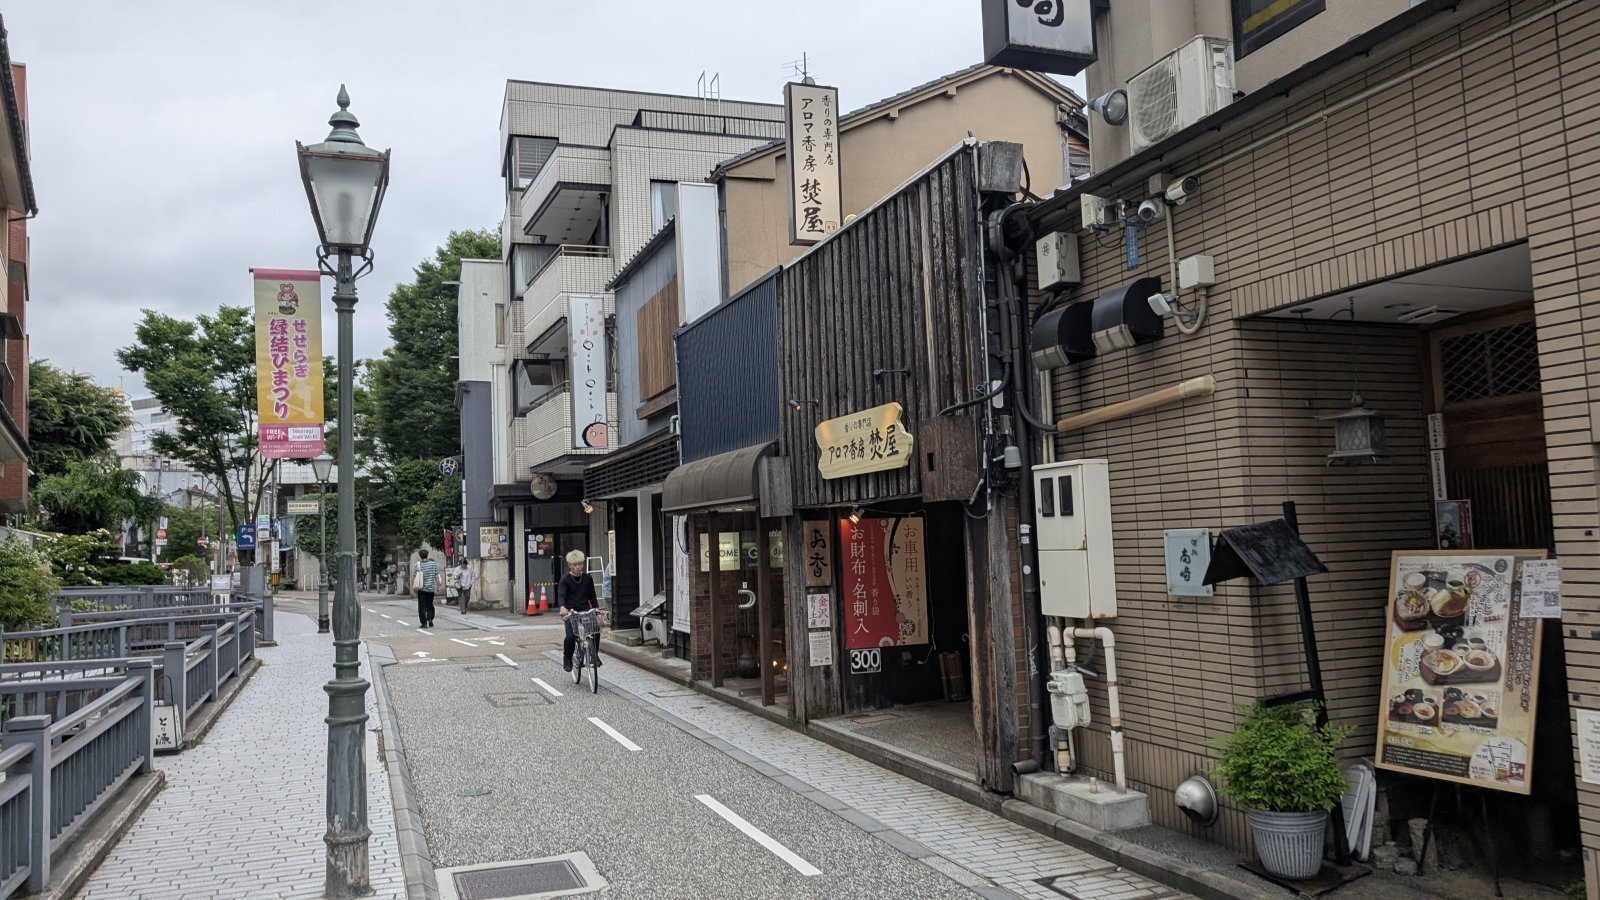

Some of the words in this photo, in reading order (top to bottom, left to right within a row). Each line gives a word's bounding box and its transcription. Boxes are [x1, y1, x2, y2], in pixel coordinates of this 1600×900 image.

[821, 94, 834, 166] 香りの専門店
[269, 318, 291, 420] 縁結びまつり
[292, 318, 309, 379] せせらぎ
[809, 527, 828, 579] お香
[903, 524, 919, 574] お車用
[851, 650, 881, 670] 300
